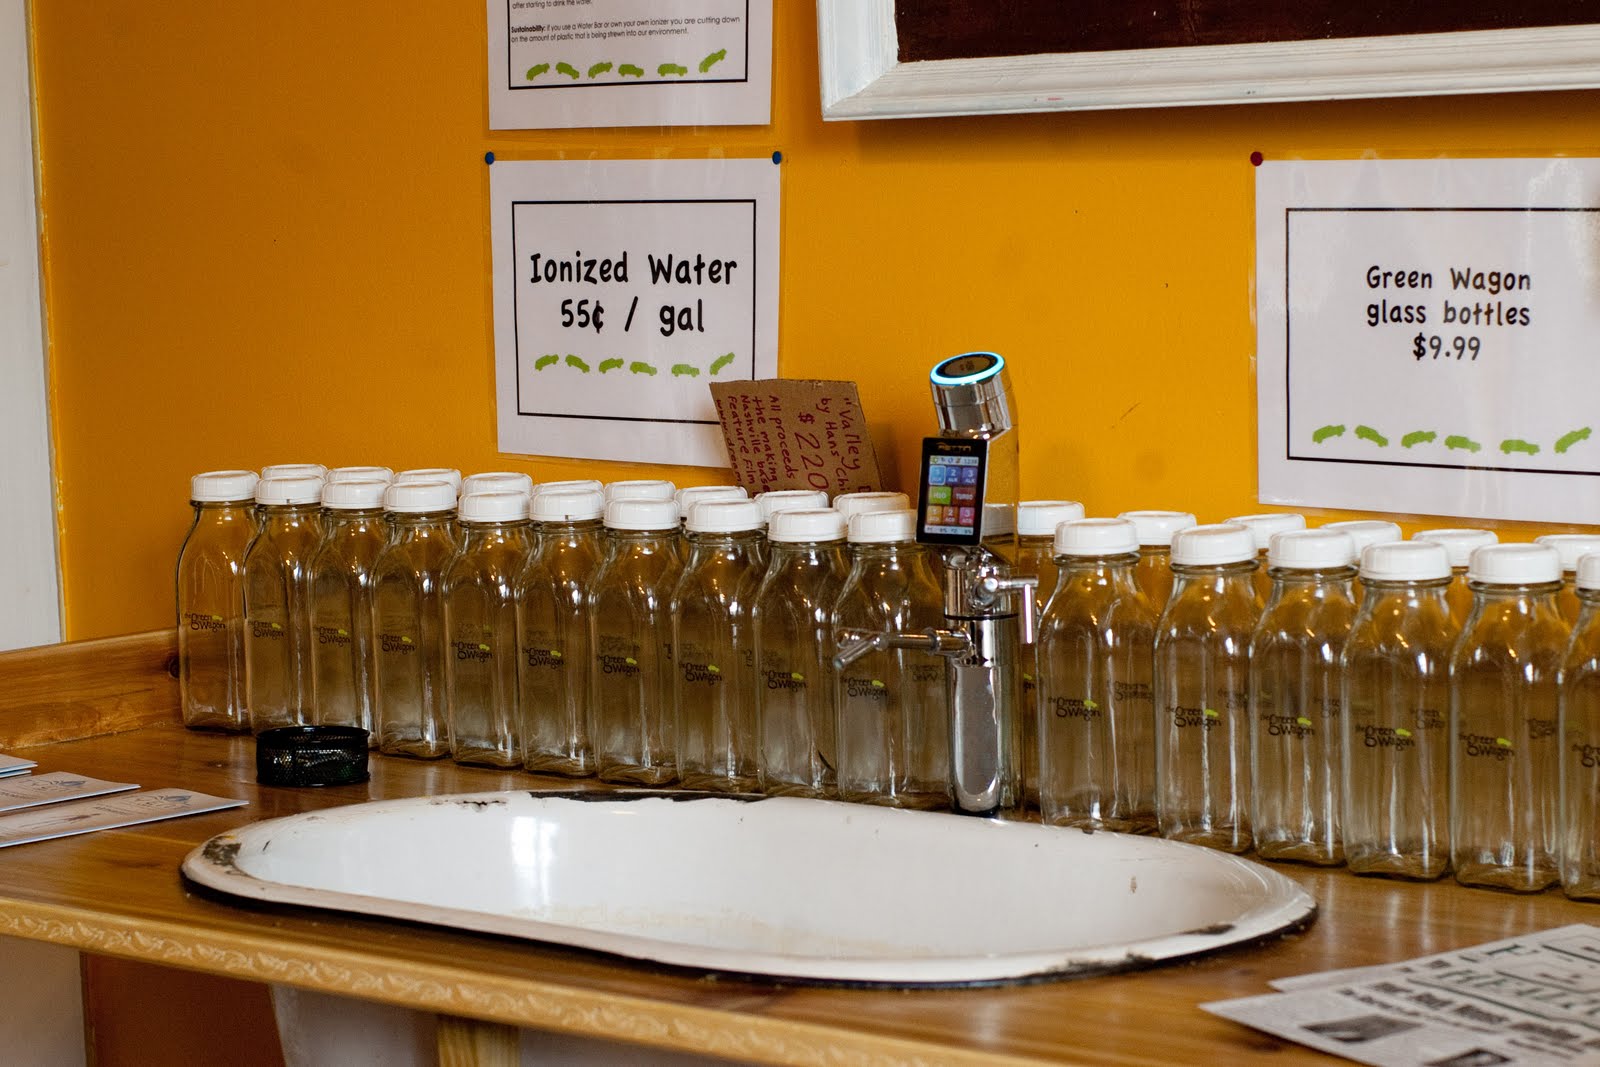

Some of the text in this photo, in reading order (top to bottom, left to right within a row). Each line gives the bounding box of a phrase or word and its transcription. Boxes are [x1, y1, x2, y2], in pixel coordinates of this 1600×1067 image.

[511, 25, 546, 33] Sustainability:
[577, 22, 592, 30] Water
[650, 18, 669, 26] ionizer
[670, 18, 682, 26] you
[697, 16, 720, 25] cutting
[529, 34, 550, 42] amount
[556, 33, 574, 41] plastic
[574, 32, 585, 40] that
[591, 31, 606, 40] being
[608, 30, 625, 38] strewn
[648, 27, 688, 36] environment.
[530, 251, 737, 285] Ionized Water
[1366, 265, 1531, 295] Green Wagon
[561, 296, 704, 337] 55¢ / gal
[1367, 299, 1531, 327] glass bottles
[1413, 332, 1481, 361] $9.99
[740, 395, 761, 454] Nashville
[816, 397, 832, 413] by
[825, 421, 840, 457] Hans
[752, 396, 778, 482] the making
[769, 395, 799, 479] All proceeds
[201, 622, 226, 632] Wagon
[261, 629, 284, 640] Wagon
[327, 636, 351, 647] Wagon
[390, 644, 416, 654] Wagon
[466, 650, 493, 663] Wagon
[537, 657, 564, 670] Wagon
[612, 664, 640, 677] Wagon
[694, 672, 722, 685] Wagon
[778, 680, 807, 692] Wagon
[858, 688, 889, 700] Wagon
[1067, 706, 1101, 721] Wagon
[1186, 716, 1222, 732] Wagon
[1280, 724, 1315, 740] Wagon
[1377, 735, 1416, 751] Wagon
[1478, 744, 1515, 761] Wagon
